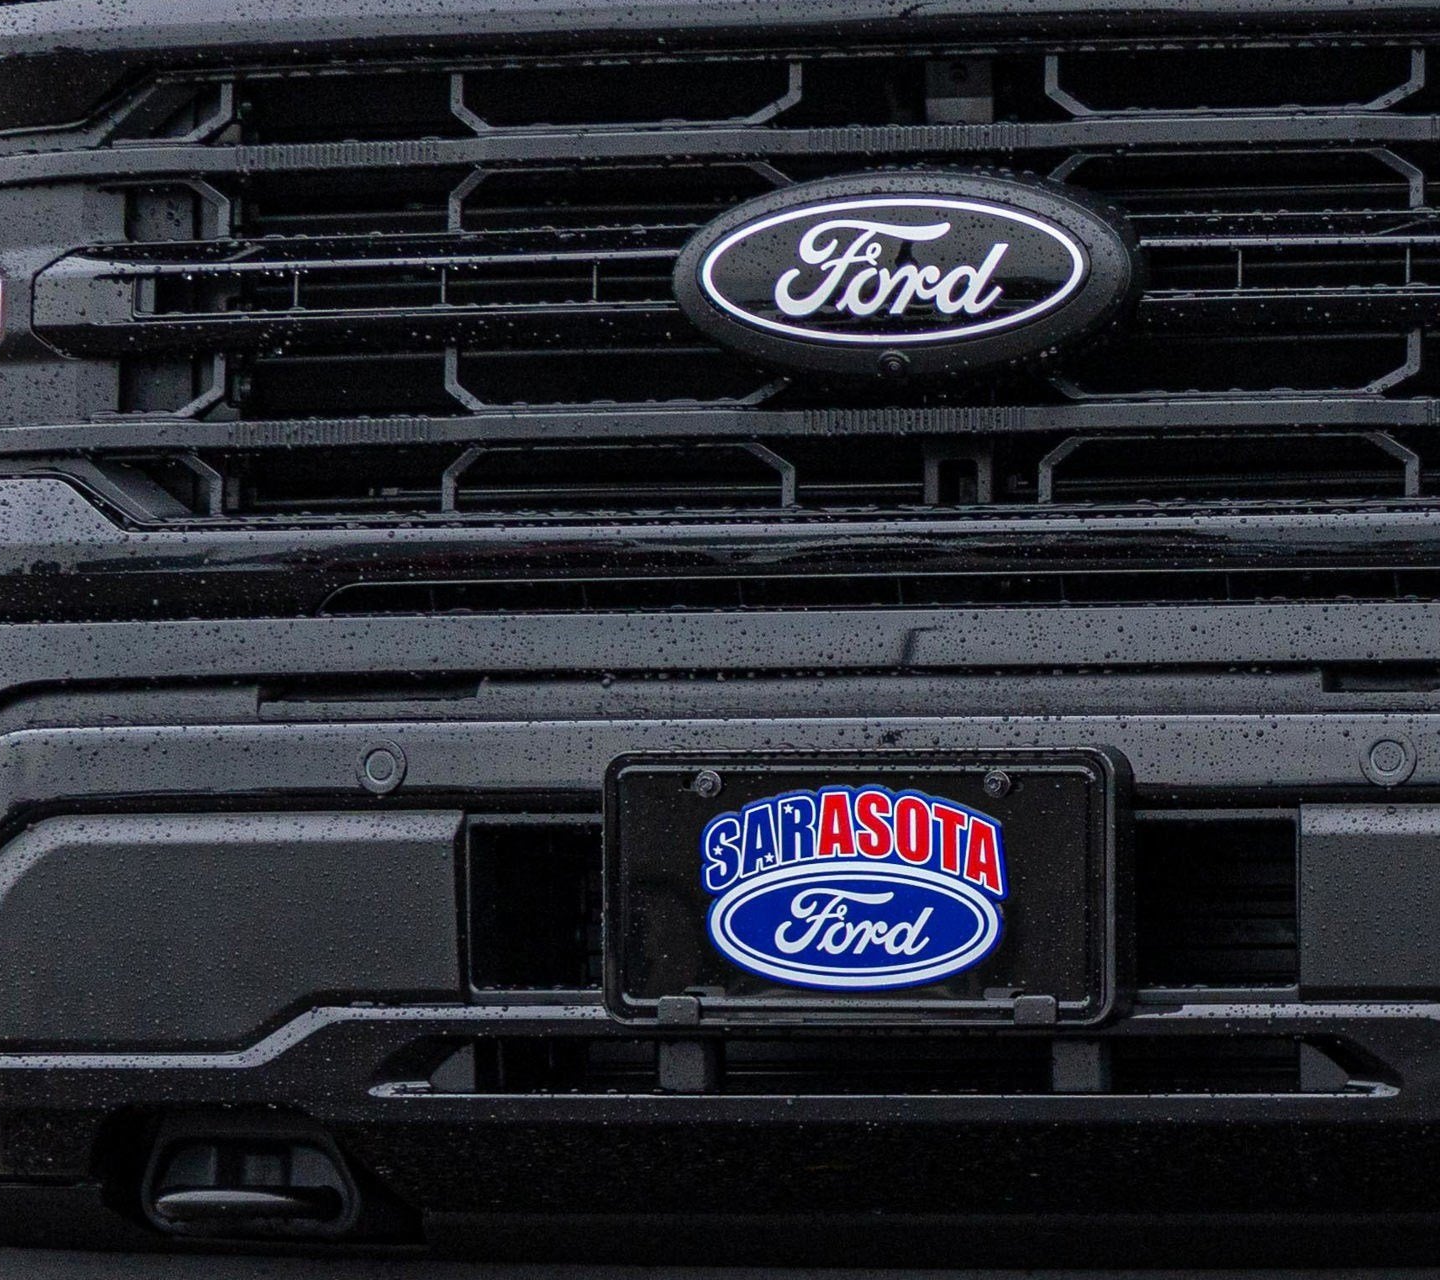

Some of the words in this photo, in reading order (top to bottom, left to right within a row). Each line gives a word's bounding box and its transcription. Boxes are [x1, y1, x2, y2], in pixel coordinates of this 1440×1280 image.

[774, 219, 1009, 317] Ford
[706, 790, 1003, 896] SARASOTA
[774, 887, 934, 956] Ford
